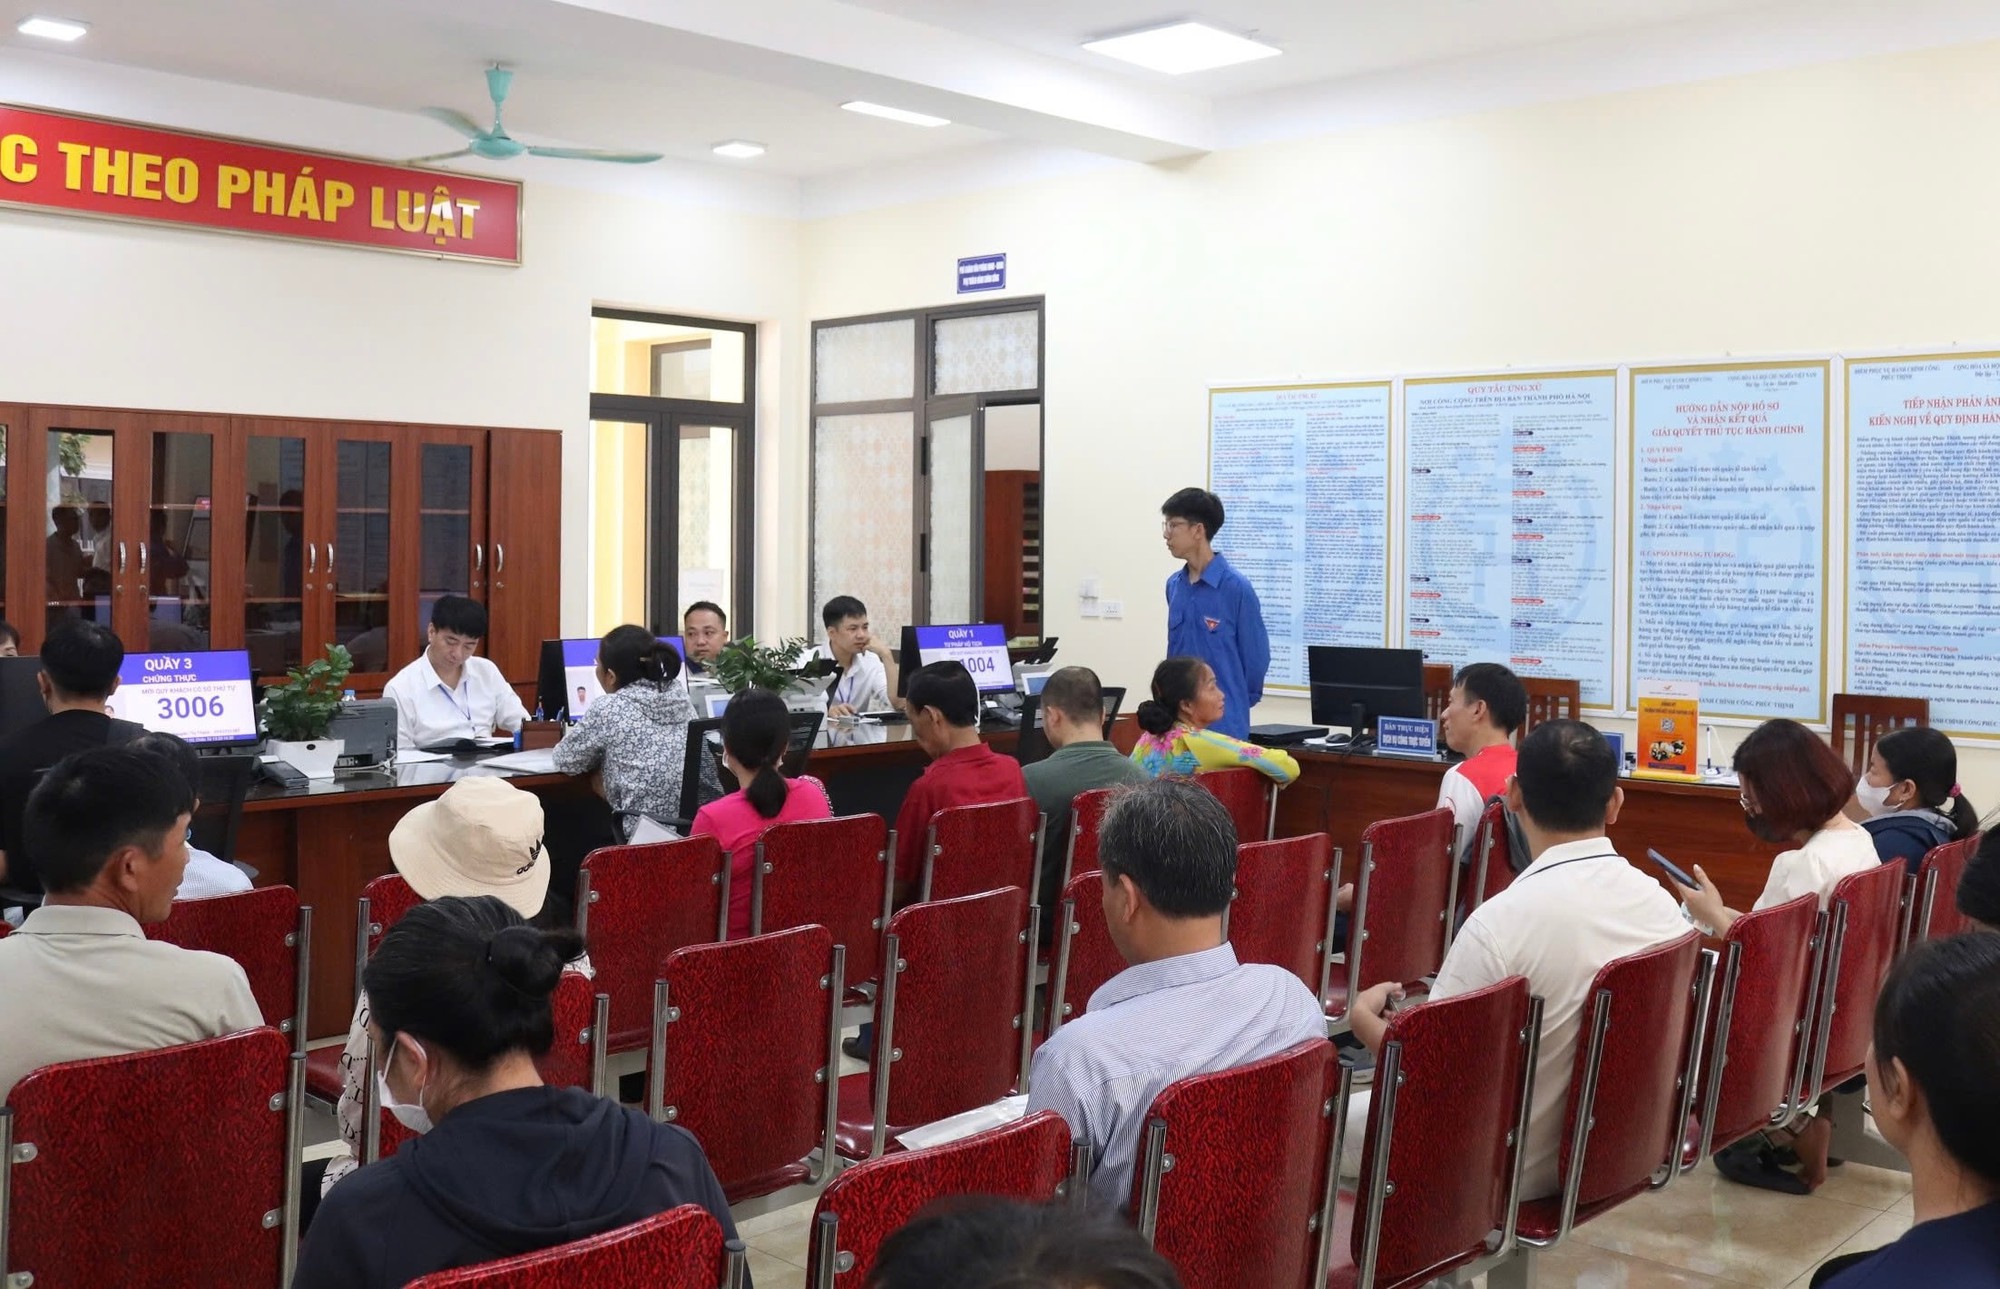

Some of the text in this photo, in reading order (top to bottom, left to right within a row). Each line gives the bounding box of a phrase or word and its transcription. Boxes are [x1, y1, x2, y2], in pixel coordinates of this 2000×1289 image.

[57, 141, 199, 204] THEO
[217, 166, 355, 223] PHÁP
[370, 185, 481, 244] LUẬT
[1676, 400, 1780, 414] HƯỚNG DẪN NỘP HỒ SƠ
[1903, 396, 1925, 409] TIẾP
[1927, 396, 1954, 410] NHẬN
[1956, 394, 1982, 408] PHẢN
[1687, 412, 1768, 426] VÀ NHẬN KẾT QUẢ
[1869, 412, 1892, 426] KIẾN
[1894, 415, 1917, 427] NGHỊ
[1919, 412, 1932, 424] VỀ
[1934, 414, 1954, 426] QUY
[1955, 414, 1980, 426] ĐỊNH
[1652, 424, 1804, 438] GIẢI QUYẾT THỦ TỤC HÀNH CHÍNH
[948, 626, 974, 639] QUẦY 1
[144, 655, 192, 671] QUẦY 3
[142, 673, 197, 683] CHỨNG THỰC
[157, 696, 224, 720] 3006
[1384, 722, 1430, 734] BÀN THỰC HIỆN
